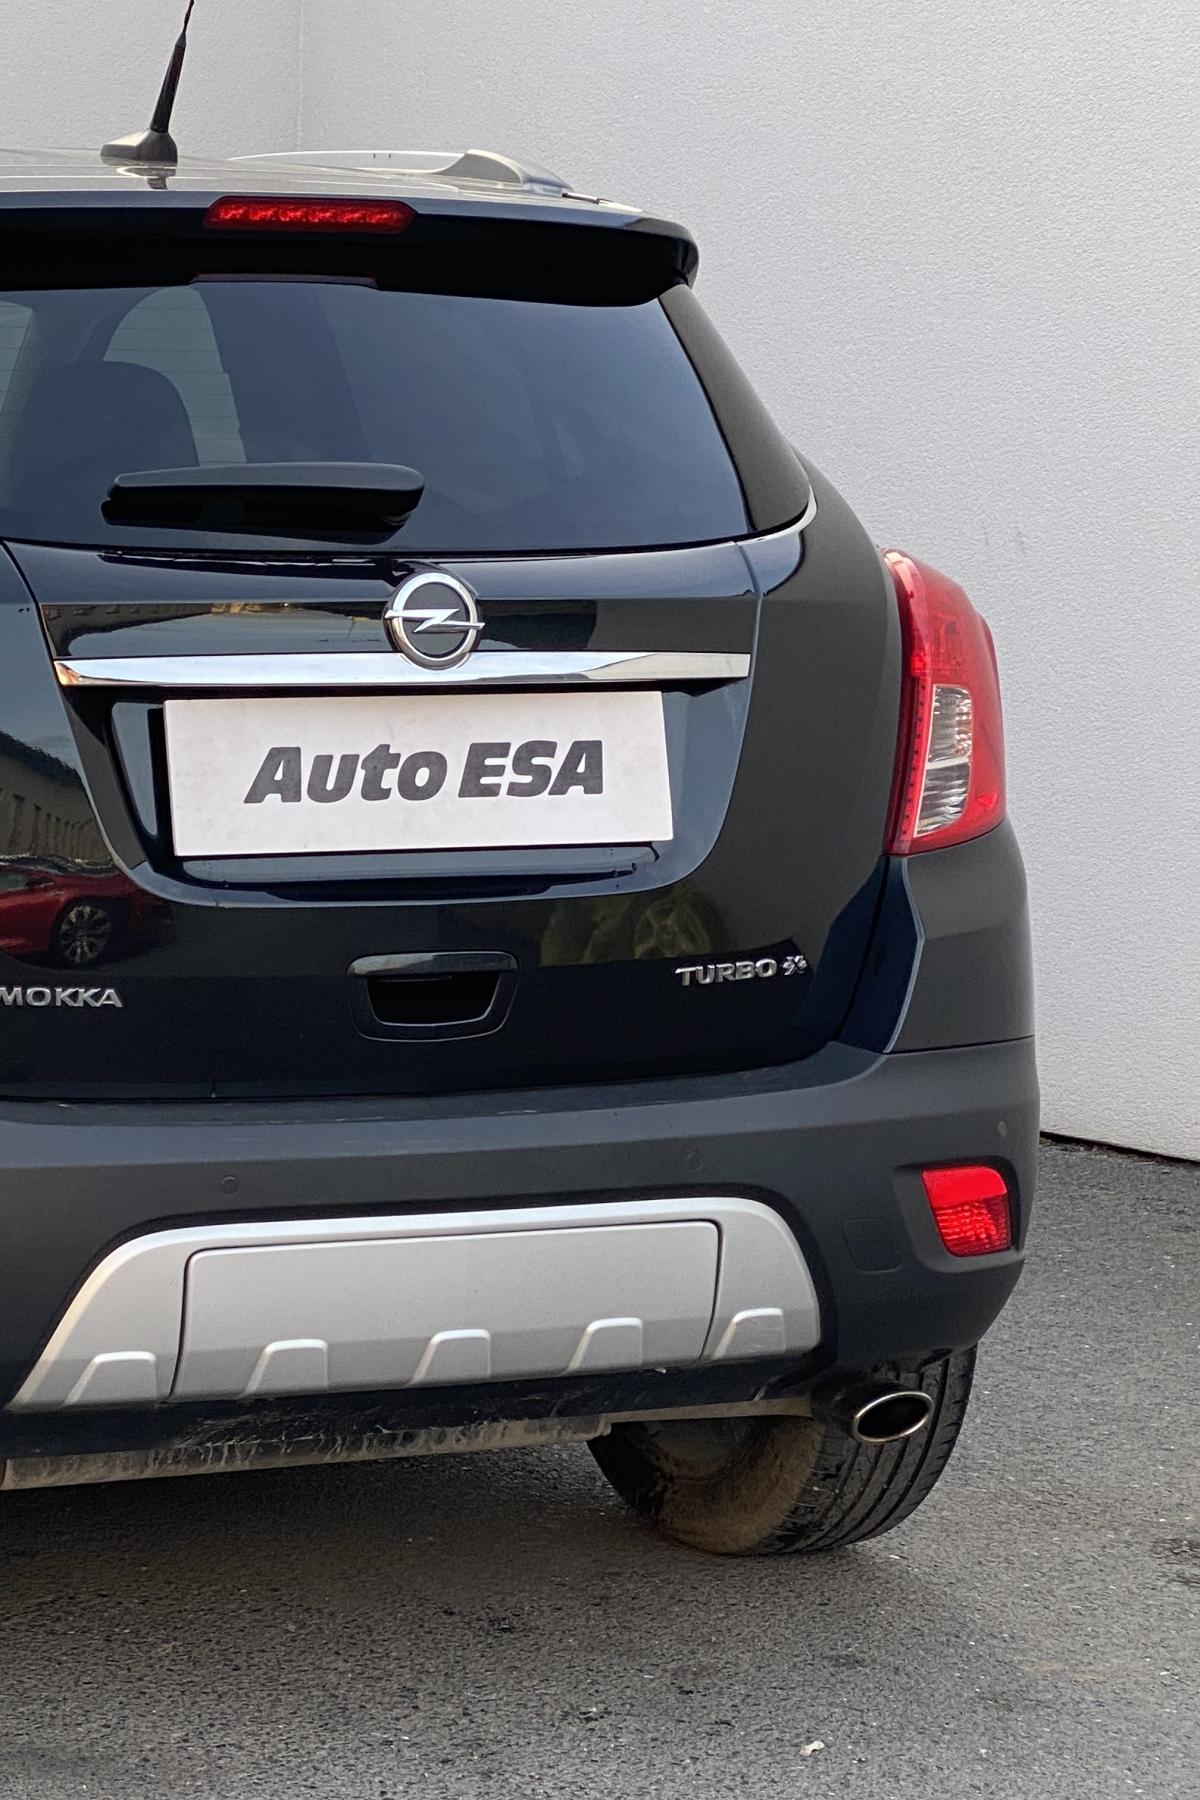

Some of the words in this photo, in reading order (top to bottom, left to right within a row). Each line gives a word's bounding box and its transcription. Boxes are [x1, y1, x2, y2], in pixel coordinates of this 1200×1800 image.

[243, 743, 448, 804] Auto
[457, 739, 604, 798] ESA
[675, 958, 777, 987] TURBO
